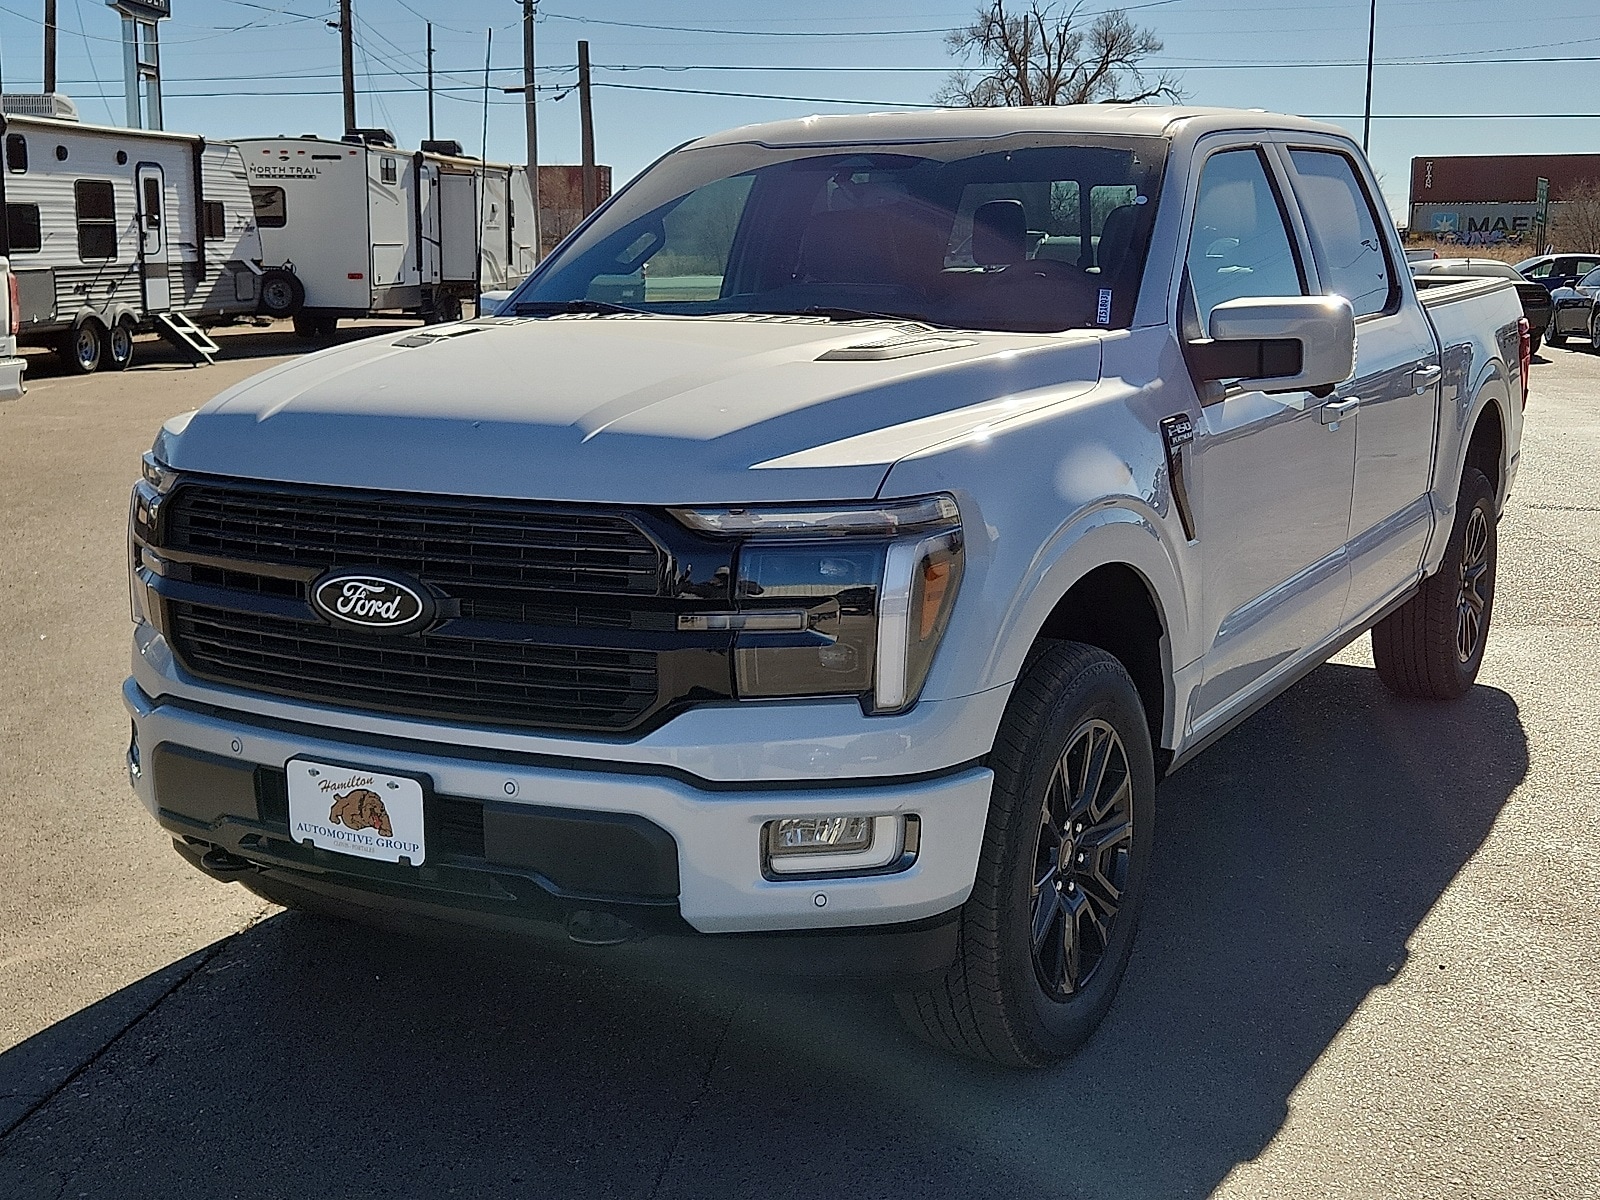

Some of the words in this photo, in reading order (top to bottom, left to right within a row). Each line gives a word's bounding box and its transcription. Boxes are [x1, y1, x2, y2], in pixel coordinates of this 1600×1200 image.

[249, 165, 286, 174] NORTH
[288, 166, 322, 175] TRAIL
[1468, 216, 1537, 231] MAE
[336, 581, 402, 620] Ford
[317, 775, 375, 793] Hamilton
[296, 822, 373, 846] AUTOMOTIVE
[375, 837, 419, 853] GROUP
